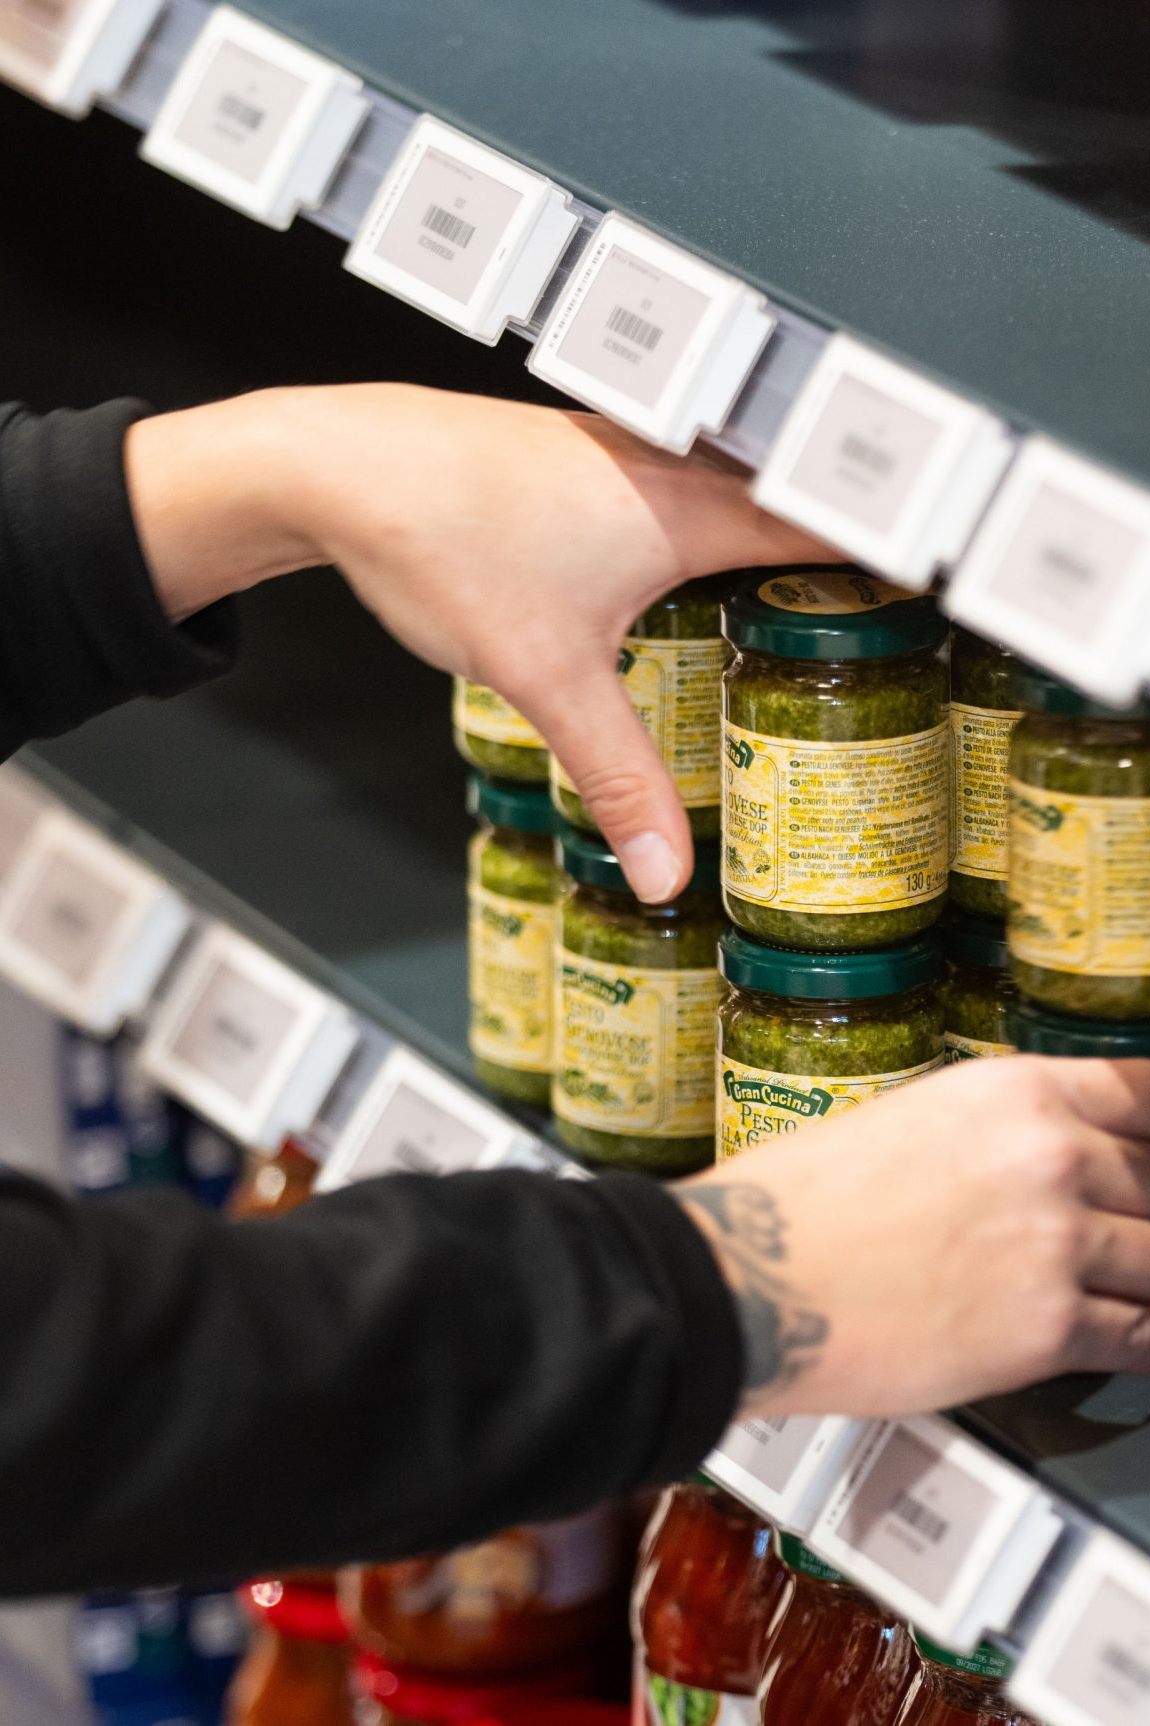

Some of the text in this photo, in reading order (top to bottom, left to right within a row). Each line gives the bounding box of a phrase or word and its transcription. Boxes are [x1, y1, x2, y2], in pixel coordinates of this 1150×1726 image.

[728, 791, 768, 821] OVESE
[801, 797, 828, 806] GENOVESE
[832, 798, 849, 807] PESTO
[750, 819, 768, 834] DOP
[801, 824, 818, 833] PESTO
[819, 825, 833, 834] NACH
[801, 851, 830, 861] ALBAHACA
[906, 871, 924, 893] 130
[926, 874, 932, 891] g
[740, 1103, 797, 1135] PESTO
[721, 1122, 742, 1148] LLA
